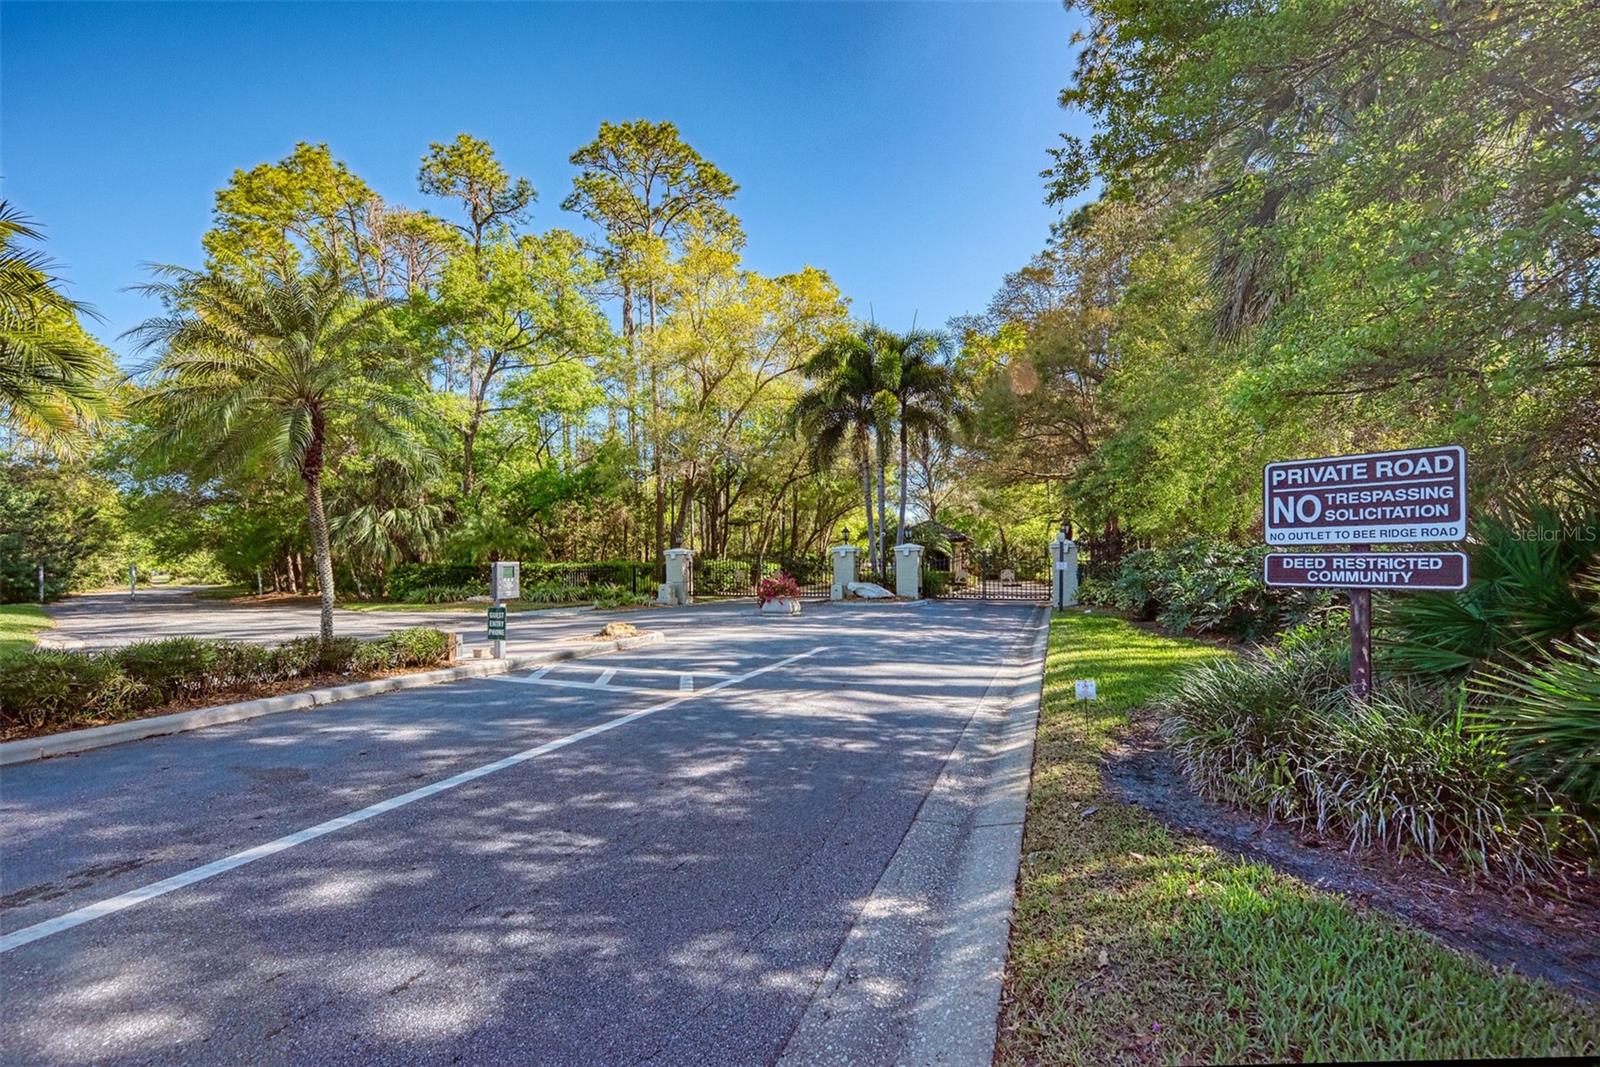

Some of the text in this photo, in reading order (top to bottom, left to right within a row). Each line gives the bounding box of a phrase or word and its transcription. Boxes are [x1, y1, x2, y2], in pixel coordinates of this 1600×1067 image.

[1272, 455, 1454, 485] PRIVATE ROAD
[1324, 486, 1454, 505] TRESPASSING
[1272, 494, 1322, 524] NO
[1324, 503, 1449, 521] SOLICITATION
[1269, 527, 1458, 541] NO OUTLET TO BEE RIDGE ROAD
[1283, 557, 1443, 570] DEED RESTRICTED
[1307, 571, 1413, 583] COMMUNITY
[488, 628, 505, 636] PHONE
